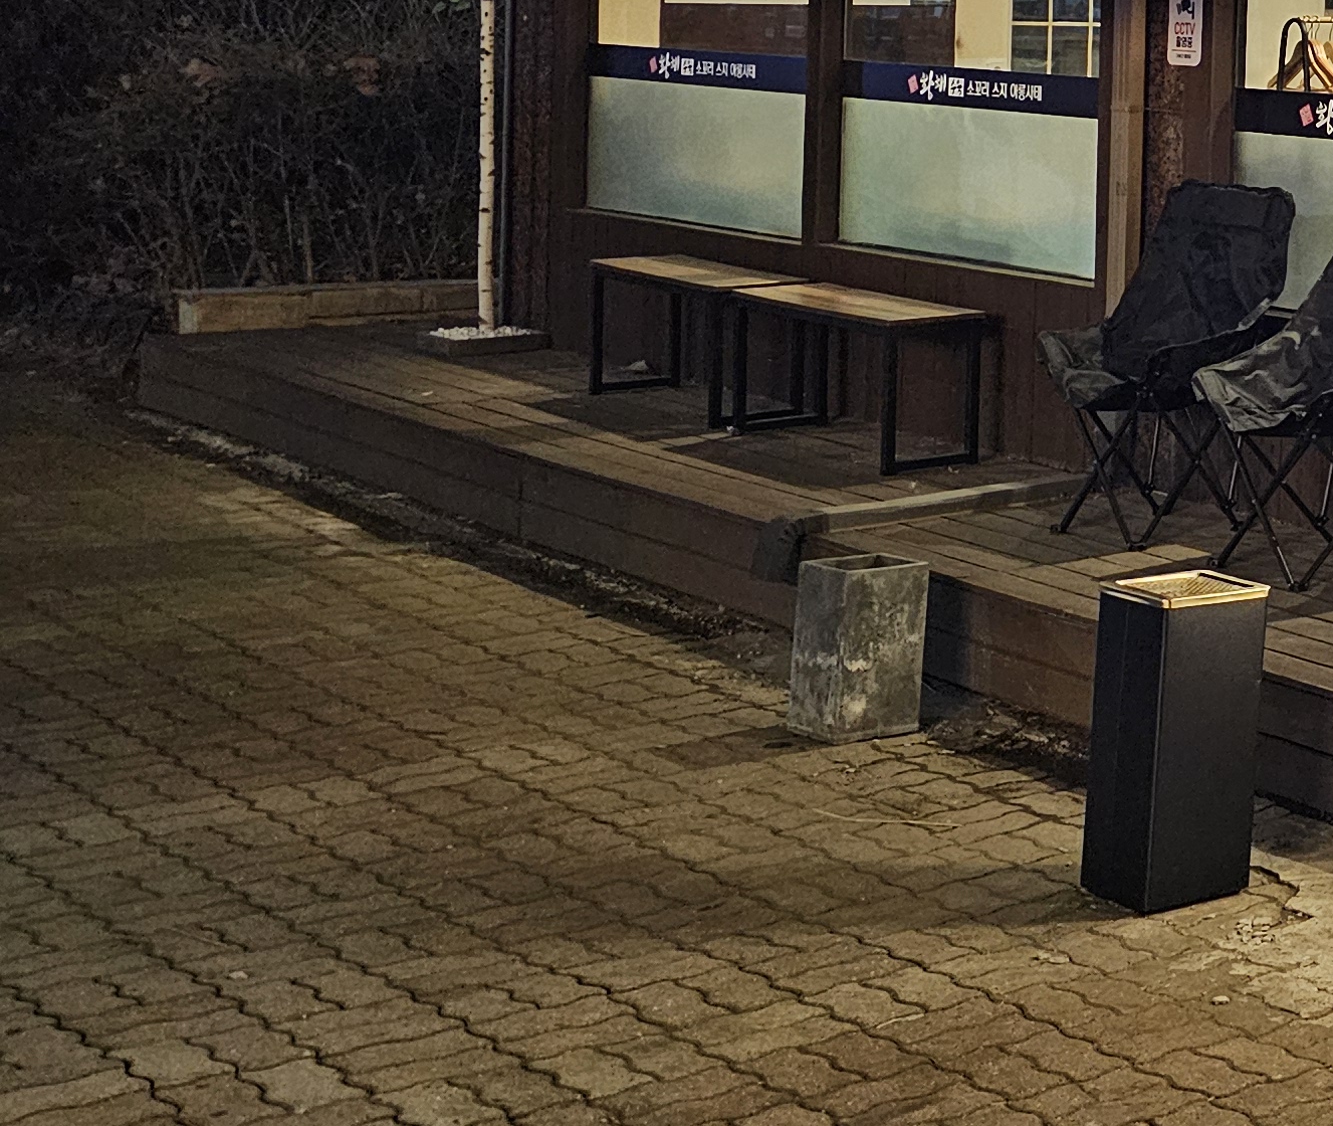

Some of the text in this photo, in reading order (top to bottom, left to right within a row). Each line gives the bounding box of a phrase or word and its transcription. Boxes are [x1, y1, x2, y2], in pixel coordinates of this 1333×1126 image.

[1174, 21, 1196, 35] CCTV
[966, 79, 991, 99] 소꼬리
[991, 80, 1009, 100] 스지
[1009, 82, 1043, 102] 아롱사태
